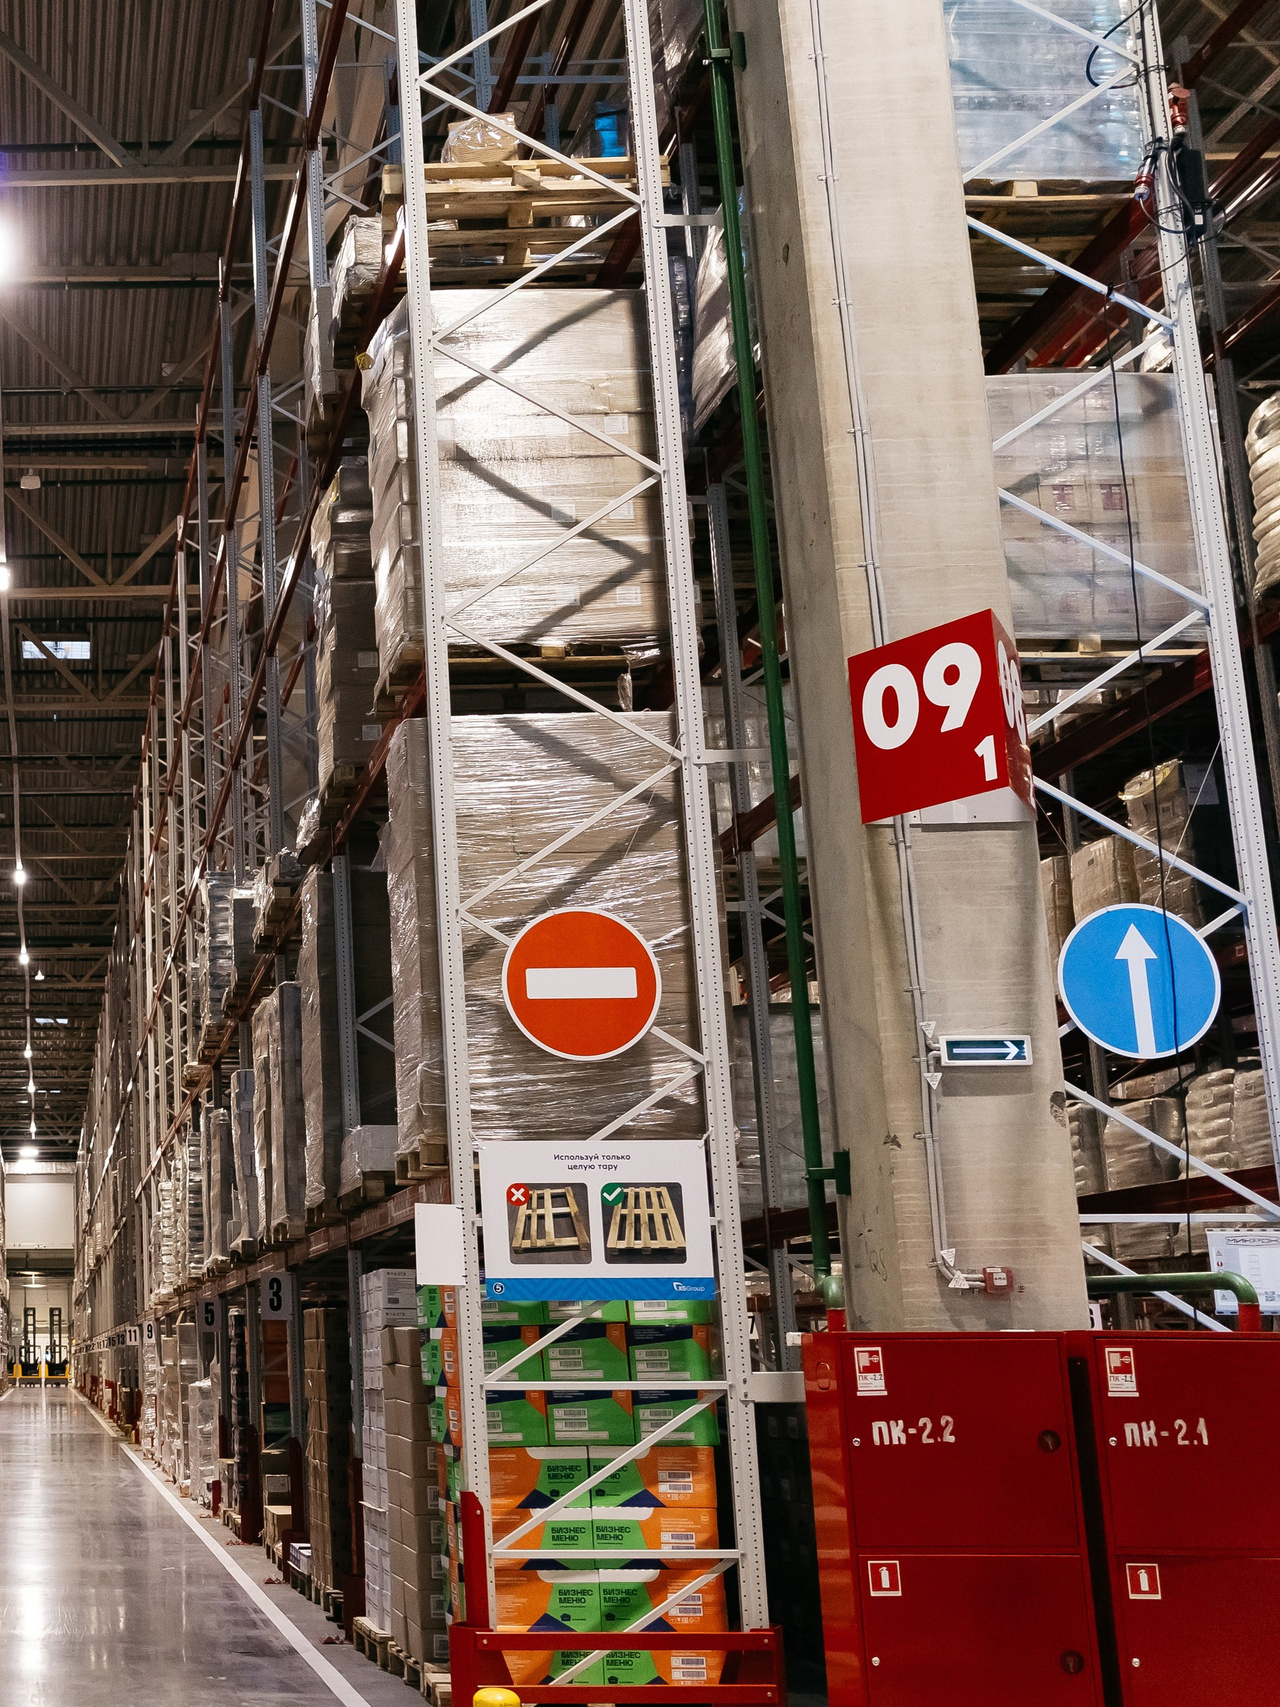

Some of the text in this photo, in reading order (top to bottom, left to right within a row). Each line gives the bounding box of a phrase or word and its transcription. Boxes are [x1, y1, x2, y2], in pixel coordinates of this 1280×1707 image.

[861, 641, 982, 751] 09
[973, 734, 999, 782] 1
[553, 1153, 600, 1162] Используй
[268, 1277, 283, 1312] 3
[204, 1302, 215, 1327] 5
[747, 1315, 756, 1335] 7
[127, 1328, 137, 1342] 11
[146, 1323, 153, 1339] 9
[108, 1336, 116, 1347] 15
[116, 1333, 125, 1346] 13
[858, 1374, 869, 1382] ПК
[871, 1414, 956, 1446] ПК-2.2
[546, 1464, 582, 1473] БИЗНЕС
[547, 1472, 575, 1480] МЕНЮ
[551, 1526, 586, 1534] БИЗНЕС
[595, 1525, 631, 1534] БИЗНЕС
[551, 1534, 579, 1542] МЕНЮ
[596, 1533, 624, 1542] МЕНЮ
[558, 1589, 594, 1597] БИЗНЕС
[603, 1588, 638, 1596] БИЗНЕС
[603, 1596, 631, 1604] МЕНЮ
[605, 1651, 641, 1659] БИЗНЕС
[606, 1659, 634, 1667] МЕНЮ
